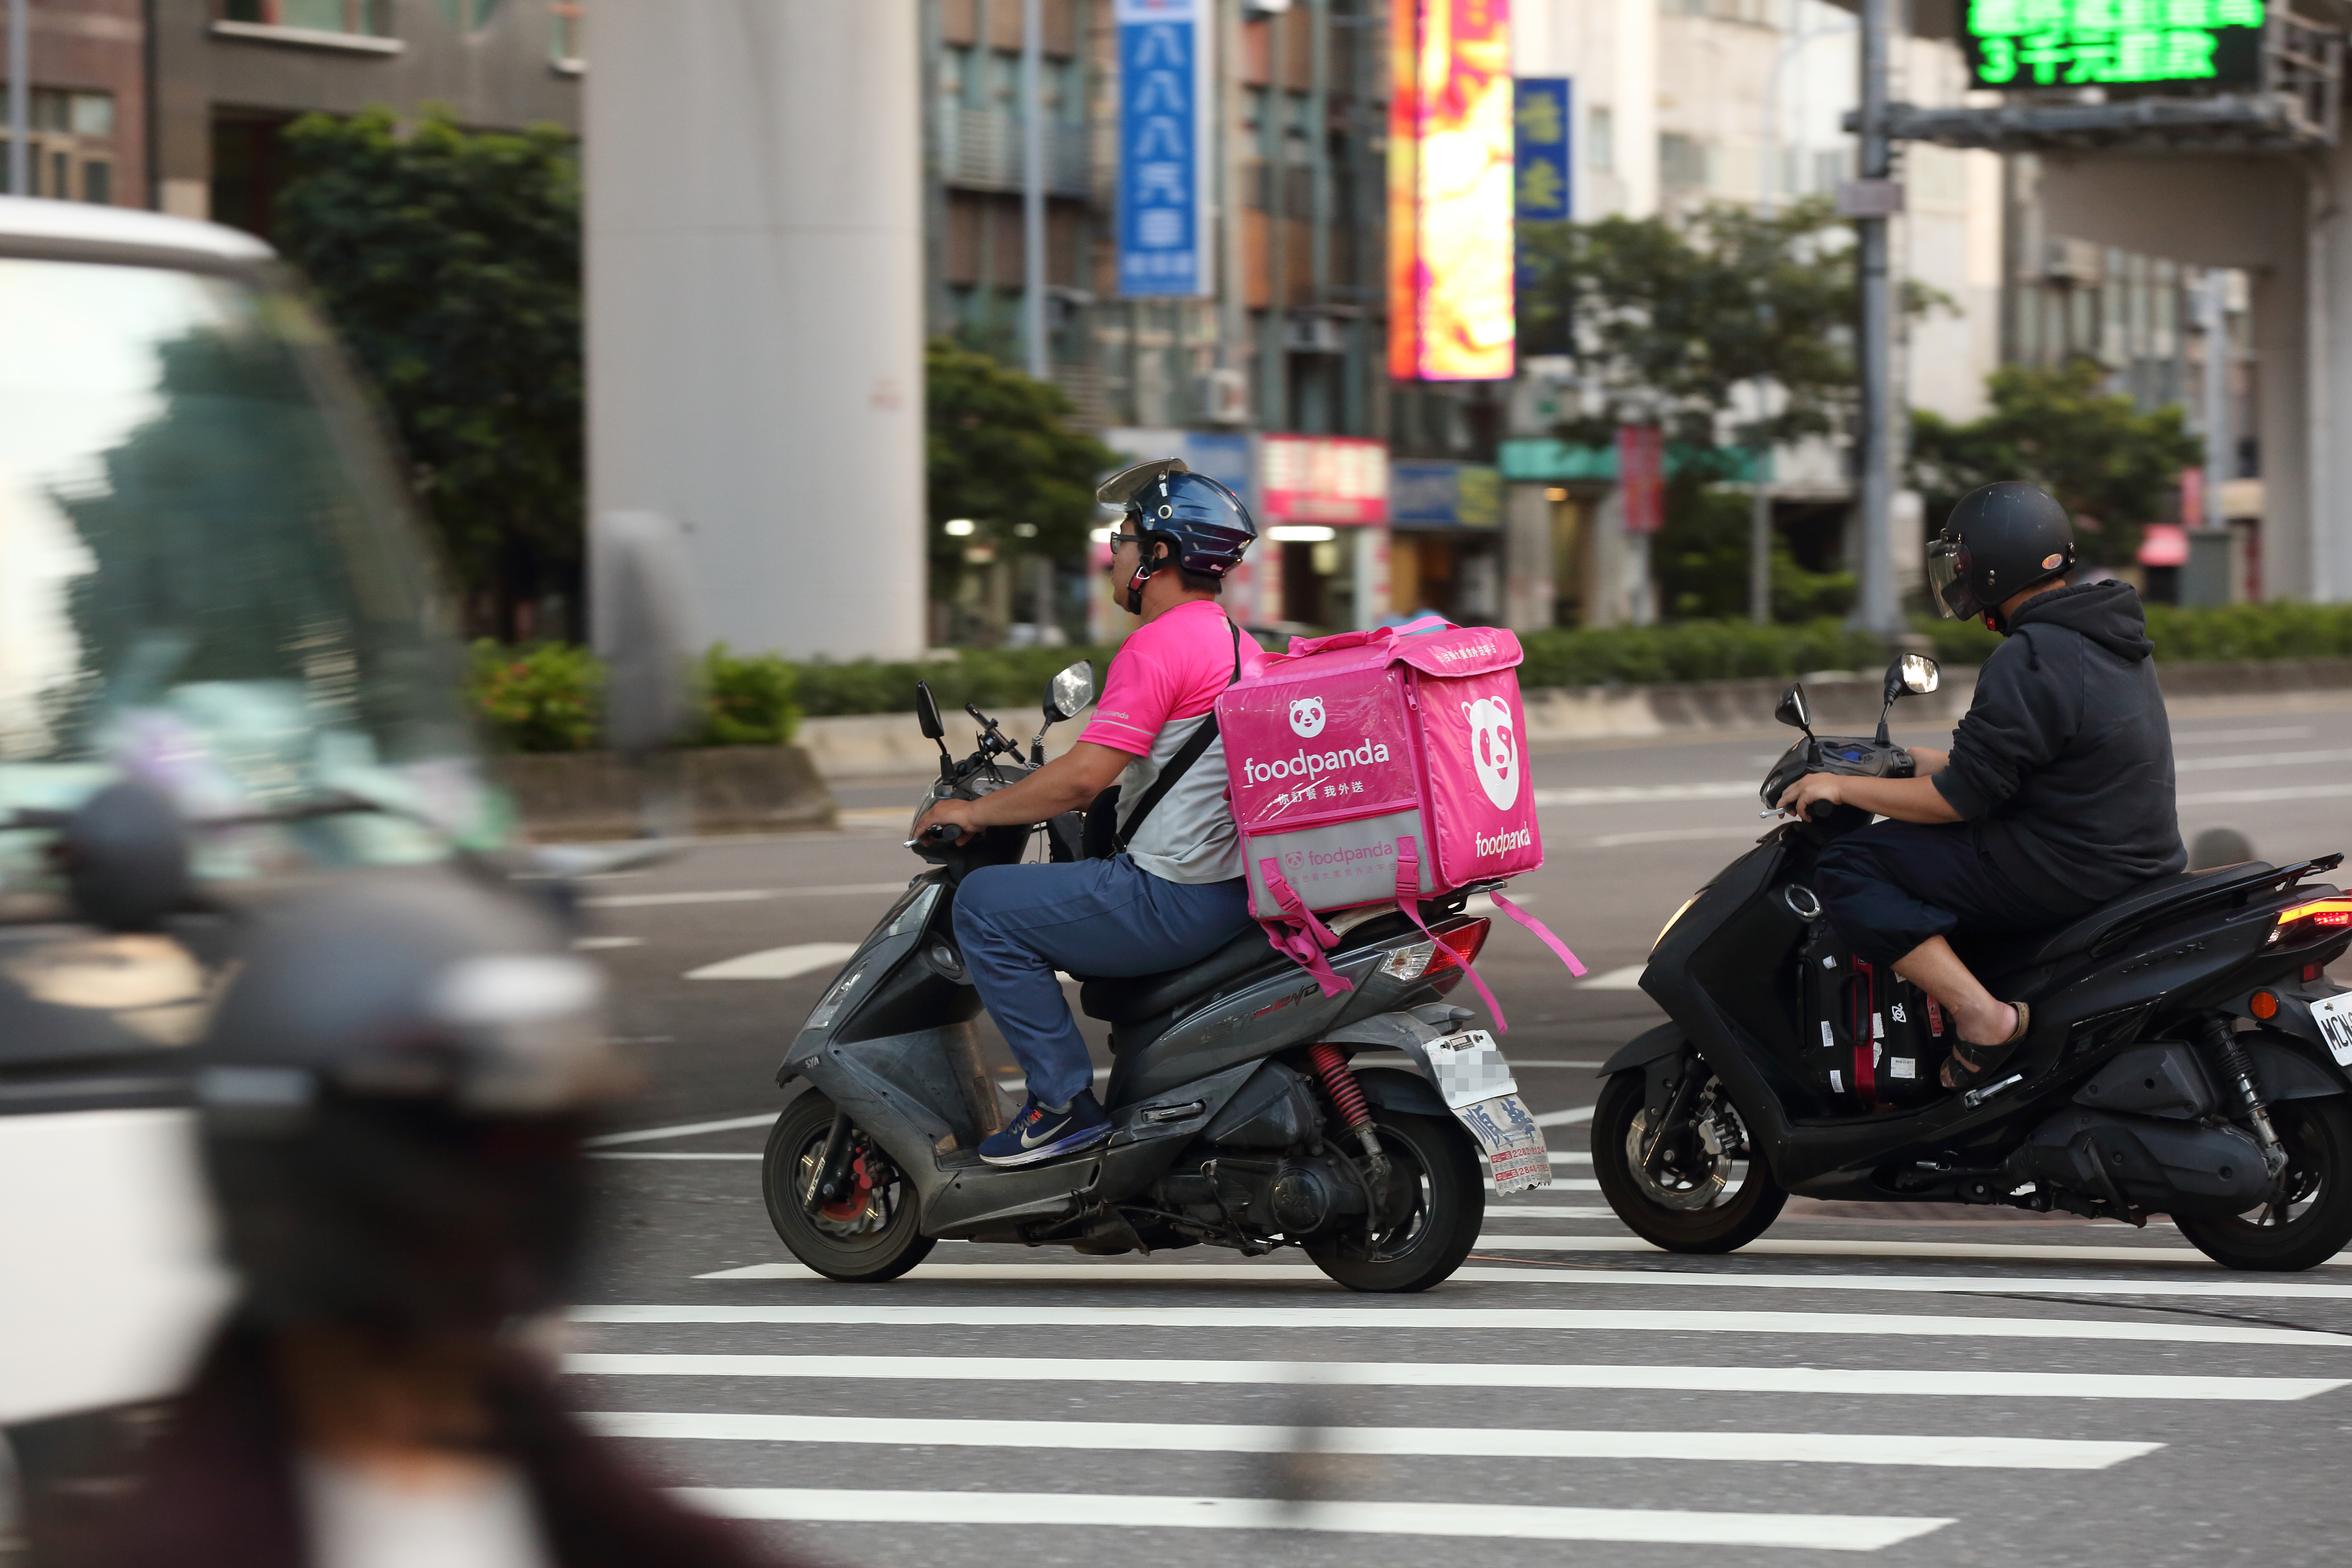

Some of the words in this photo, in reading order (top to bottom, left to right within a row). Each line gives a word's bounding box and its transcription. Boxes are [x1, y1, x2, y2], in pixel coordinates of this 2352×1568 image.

[1244, 738, 1390, 784] foodpanda
[1324, 781, 1364, 797] 我外送
[1475, 821, 1531, 859] foodpanda
[1308, 841, 1393, 866] foodpanda
[805, 1056, 820, 1069] SYM
